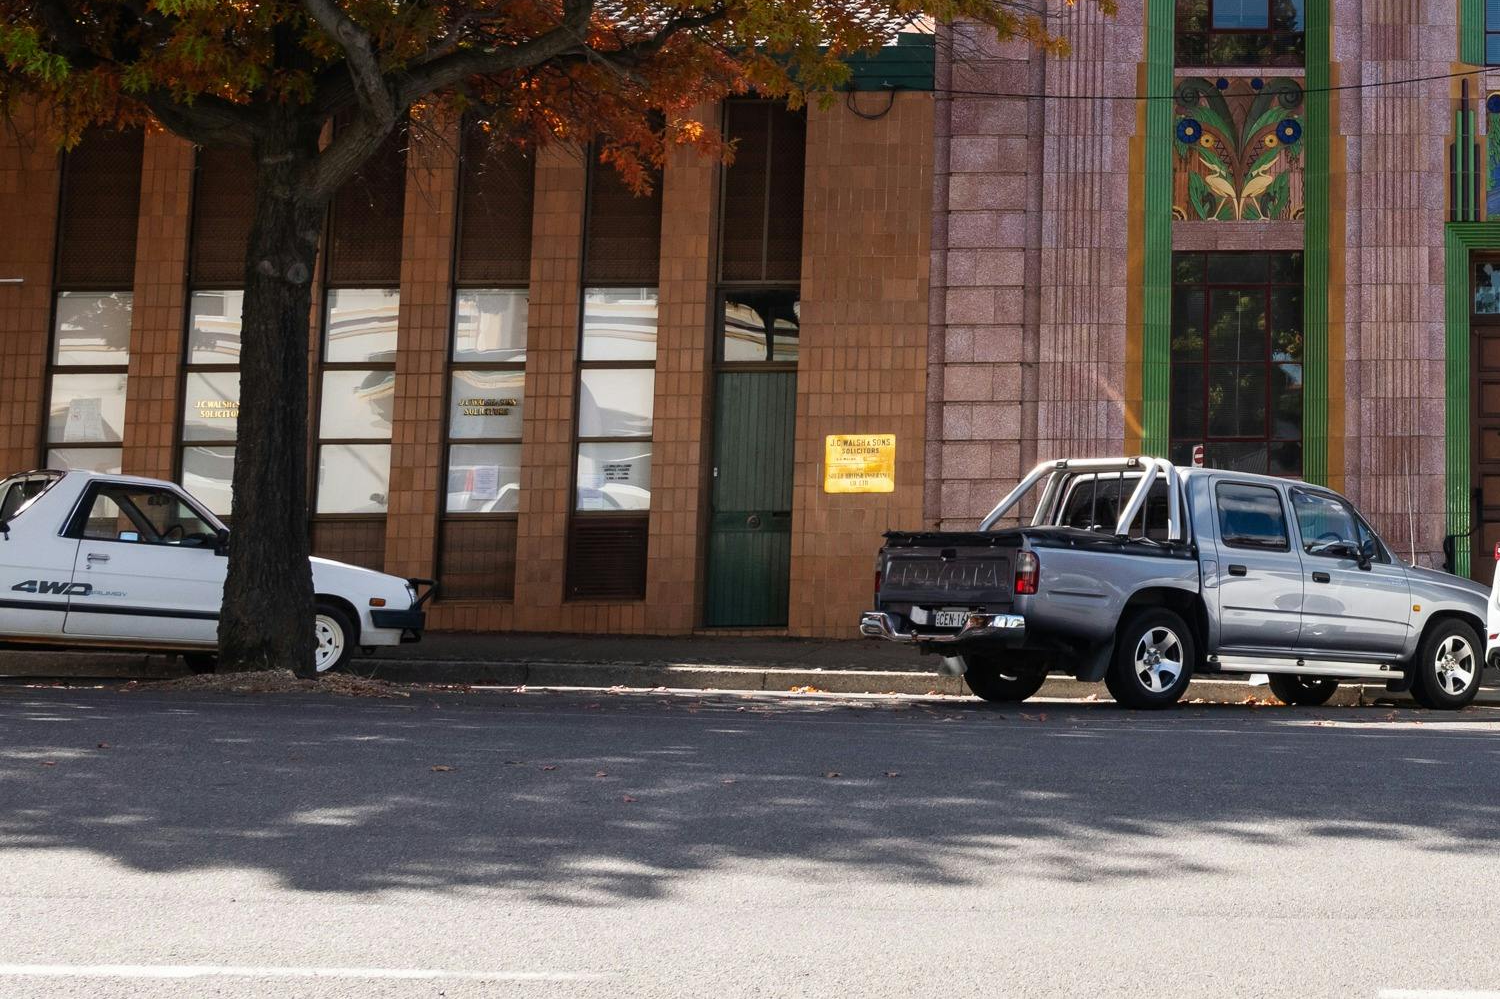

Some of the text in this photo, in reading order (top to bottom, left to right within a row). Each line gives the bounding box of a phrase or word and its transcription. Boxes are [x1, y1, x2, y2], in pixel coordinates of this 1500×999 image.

[843, 439, 866, 447] WALSH
[872, 438, 891, 447] SONS
[12, 580, 93, 596] 4WD
